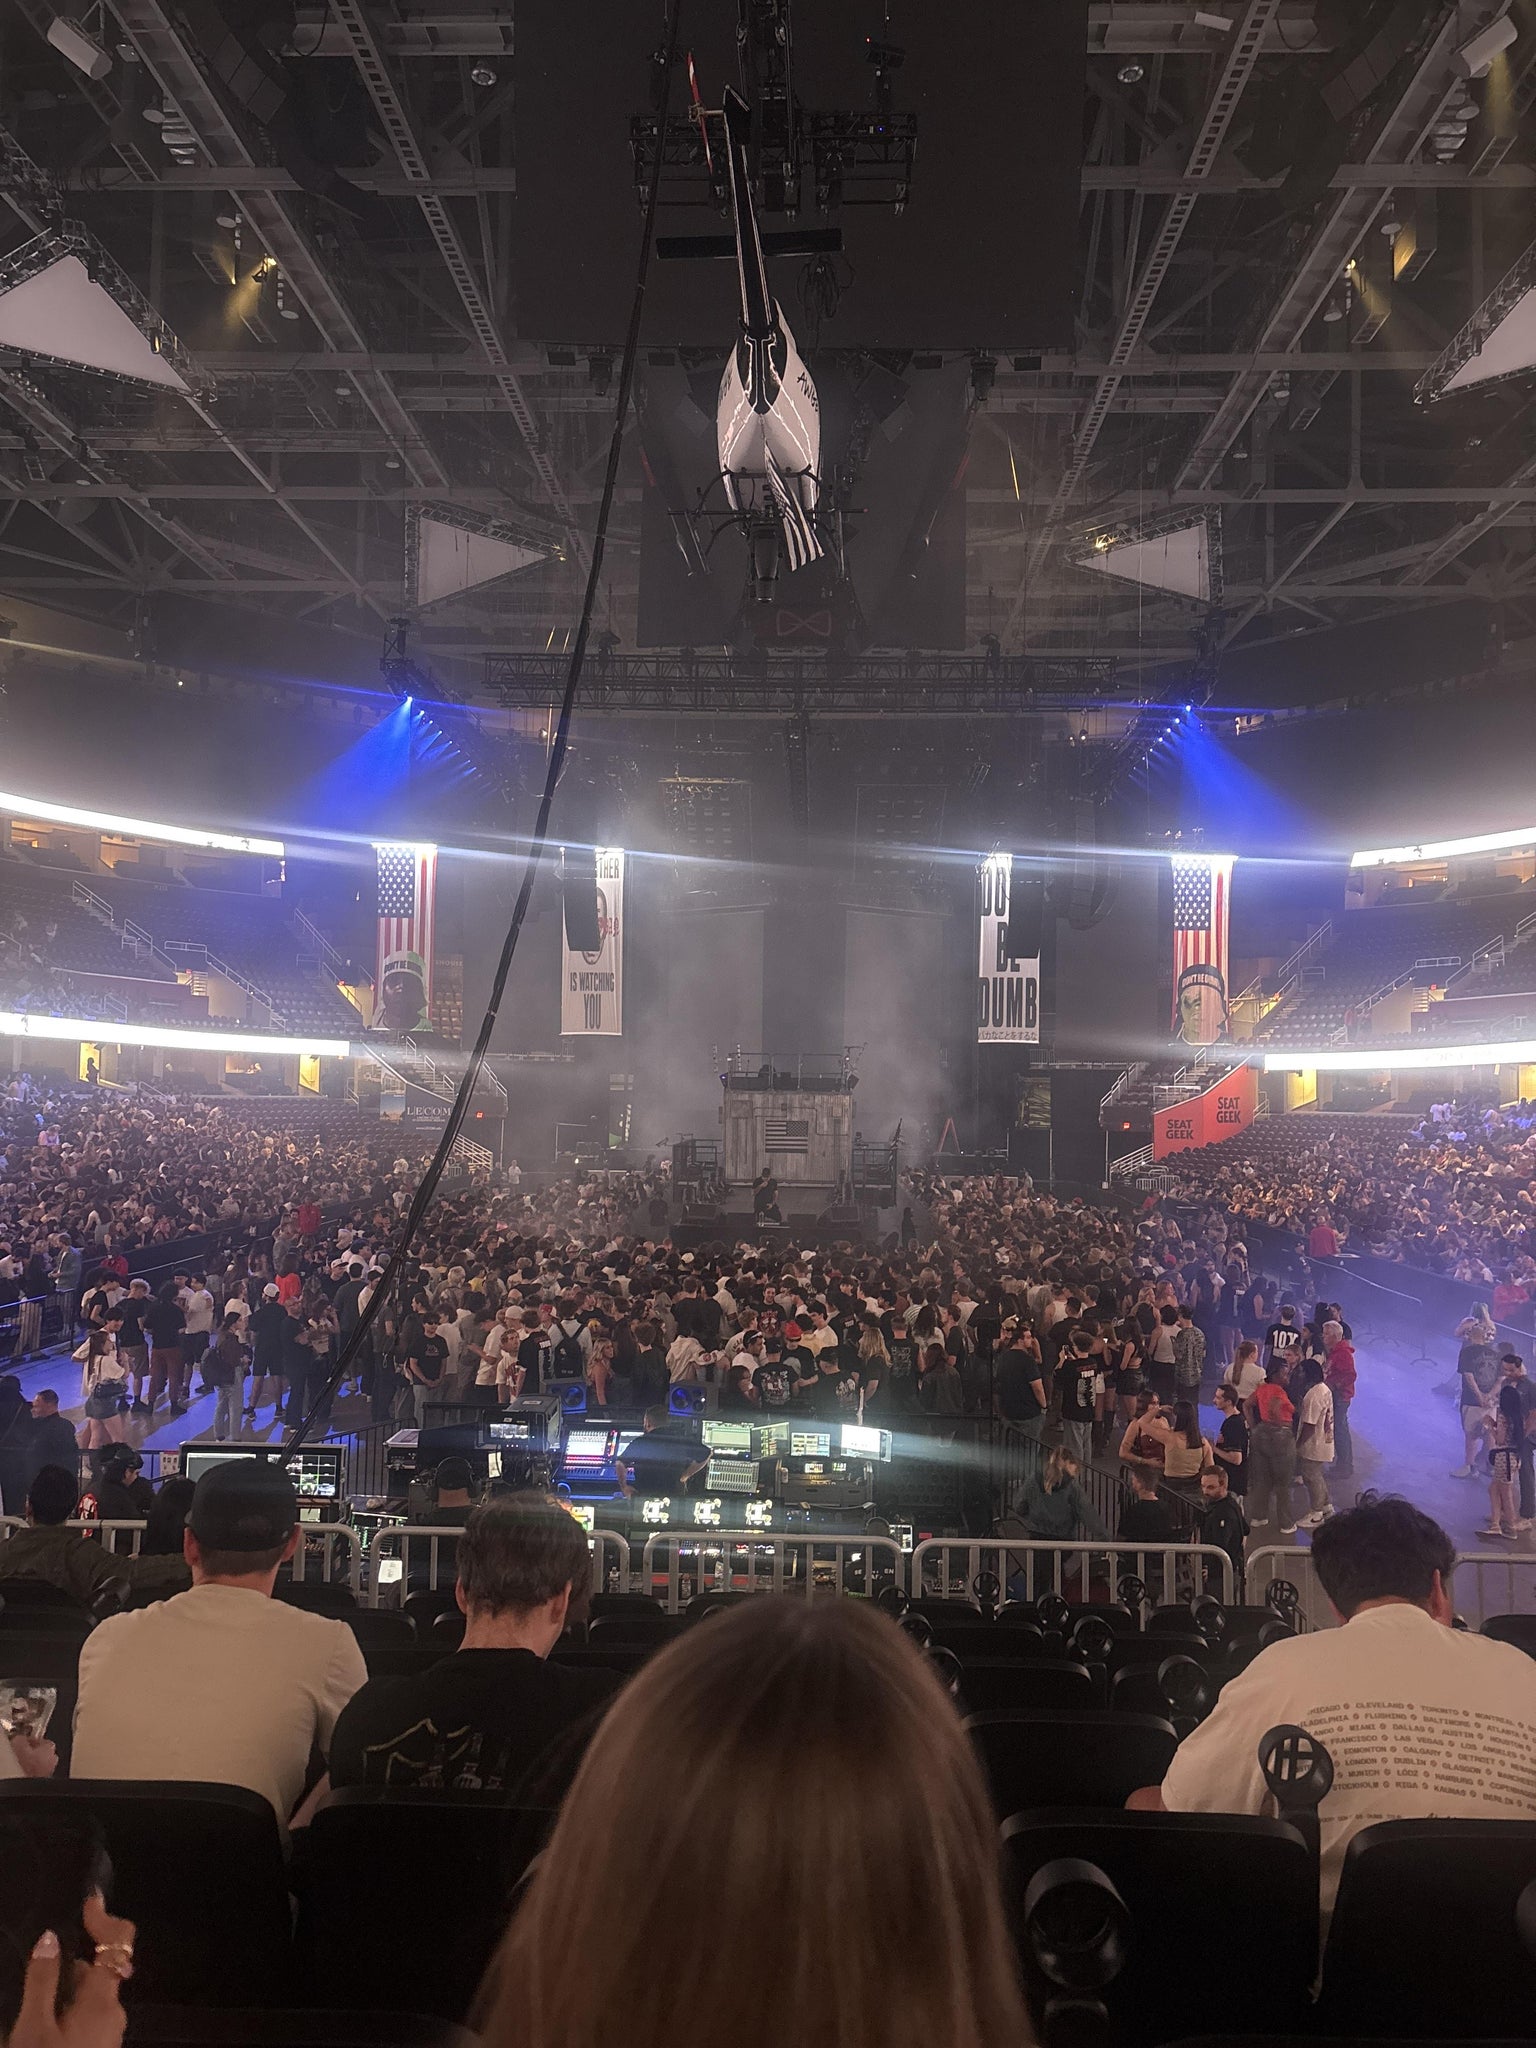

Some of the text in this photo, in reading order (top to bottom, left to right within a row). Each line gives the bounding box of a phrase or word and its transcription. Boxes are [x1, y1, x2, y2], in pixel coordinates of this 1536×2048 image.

[597, 857, 620, 879] THER
[996, 921, 1020, 973] B
[570, 972, 615, 992] IS WATCHING
[583, 993, 602, 1029] YOU
[978, 977, 1037, 1028] DUMB
[407, 1106, 452, 1116] LECOM
[1217, 1097, 1240, 1110] SEAT
[1167, 1119, 1193, 1129] SEAT
[1216, 1111, 1241, 1123] GEEK
[1166, 1130, 1193, 1140] GEEK
[1421, 1705, 1459, 1715] TORONTO
[1423, 1716, 1471, 1727] BALTIMORE
[1487, 1725, 1520, 1738] ATLANTA
[1392, 1724, 1425, 1732] DALLAS
[1442, 1729, 1474, 1739] AUSTIN
[1489, 1736, 1525, 1750] HOUSTON
[1330, 1735, 1378, 1745] FRANCISCO
[1416, 1736, 1444, 1746] VEGAS
[1460, 1742, 1477, 1751] LOS
[1482, 1745, 1518, 1759] ANGELES
[1343, 1746, 1387, 1755] EDMONTON
[1403, 1746, 1441, 1757] CALGARY
[1457, 1753, 1495, 1764] DETROIT
[1344, 1758, 1377, 1766] LONDON
[1393, 1757, 1426, 1766] DUBLIN
[1442, 1763, 1481, 1774] GLASGOW
[1348, 1769, 1380, 1777] MUNICH
[1435, 1773, 1474, 1785] HAMBURG
[1395, 1781, 1418, 1789] RIGA
[1434, 1785, 1467, 1797] KAUNAS
[1482, 1793, 1514, 1805] BERLIN
